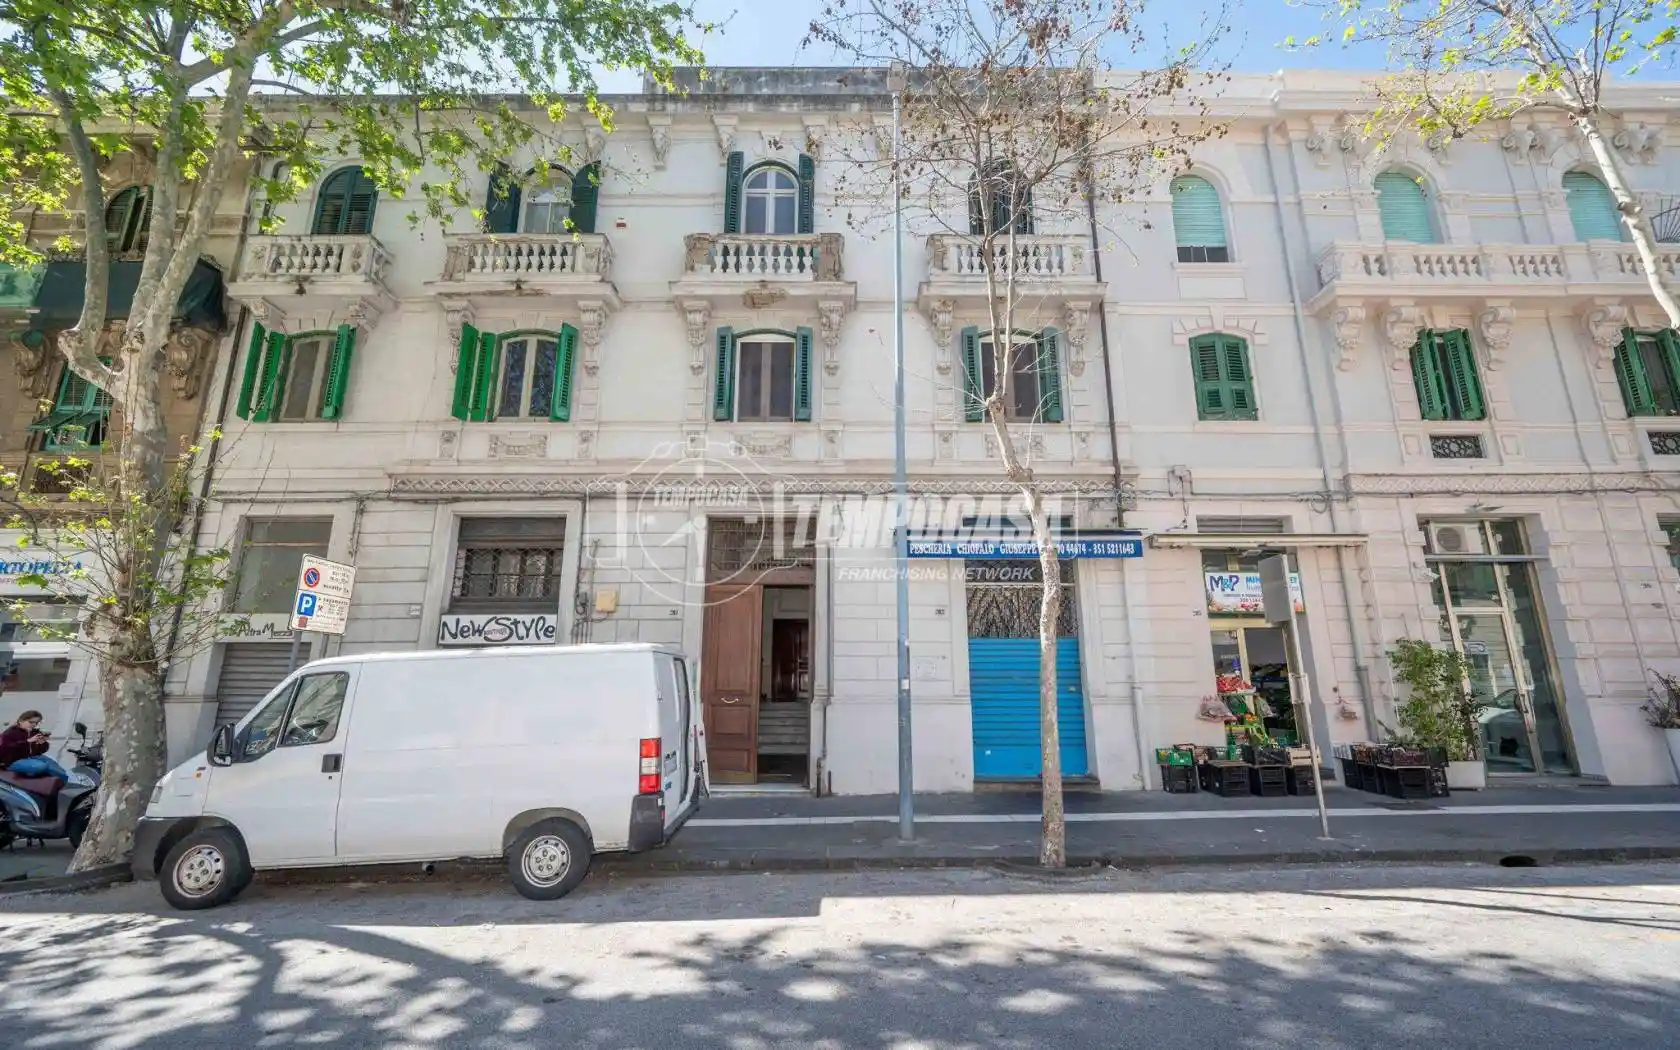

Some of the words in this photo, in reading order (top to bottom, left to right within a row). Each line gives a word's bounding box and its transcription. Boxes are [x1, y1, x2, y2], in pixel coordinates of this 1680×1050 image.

[910, 543, 952, 555] PESCHERIA
[1000, 543, 1038, 555] GIUSEPPE
[301, 595, 313, 613] P
